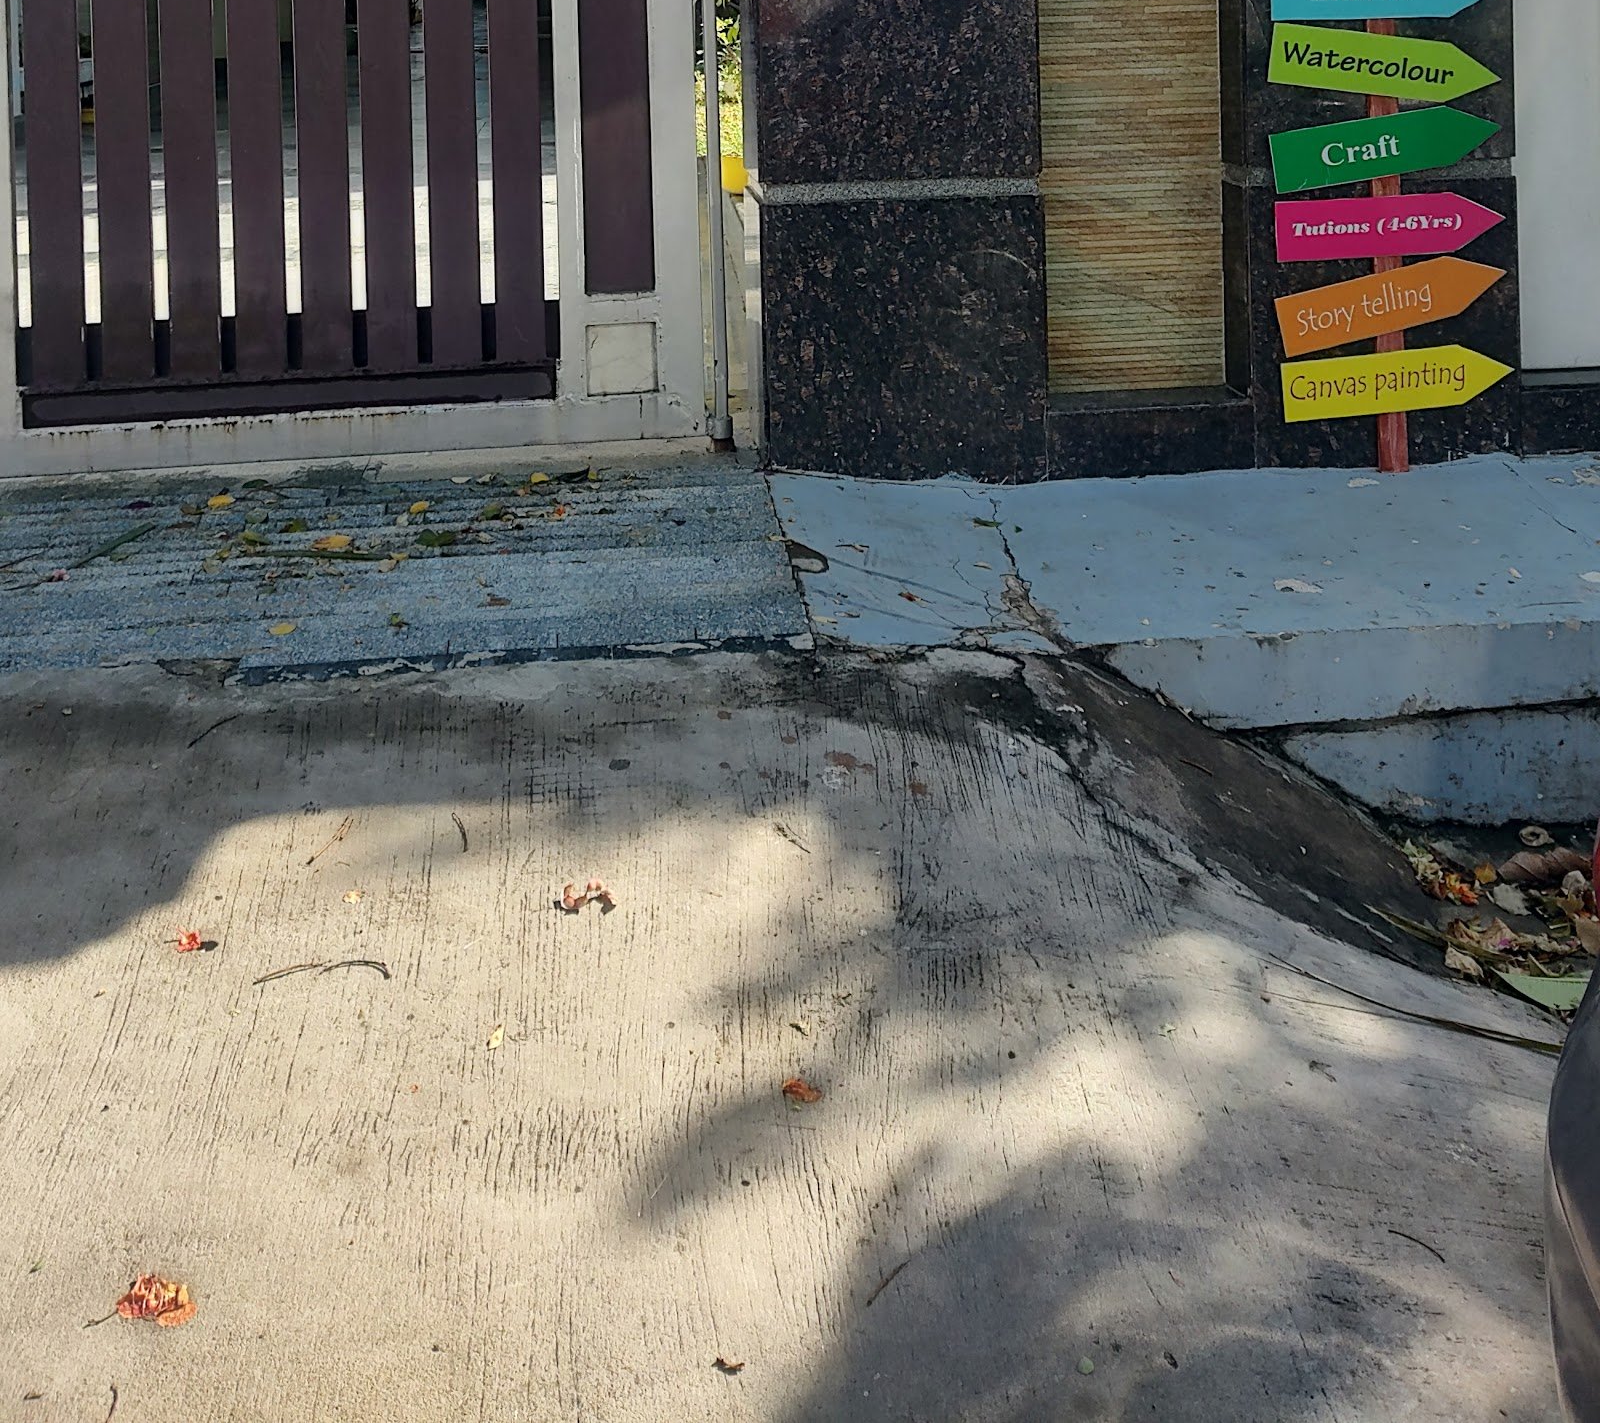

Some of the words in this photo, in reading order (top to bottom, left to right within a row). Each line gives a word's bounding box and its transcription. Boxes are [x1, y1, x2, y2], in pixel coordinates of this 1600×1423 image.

[1283, 41, 1454, 85] Watercolour
[1321, 134, 1400, 166] Craft
[1292, 220, 1370, 237] Tutions
[1376, 213, 1462, 236] (4-6Yrs)
[1296, 302, 1356, 336] Story
[1361, 282, 1432, 318] telling
[1289, 374, 1367, 401] Canvas
[1375, 363, 1466, 400] painting
